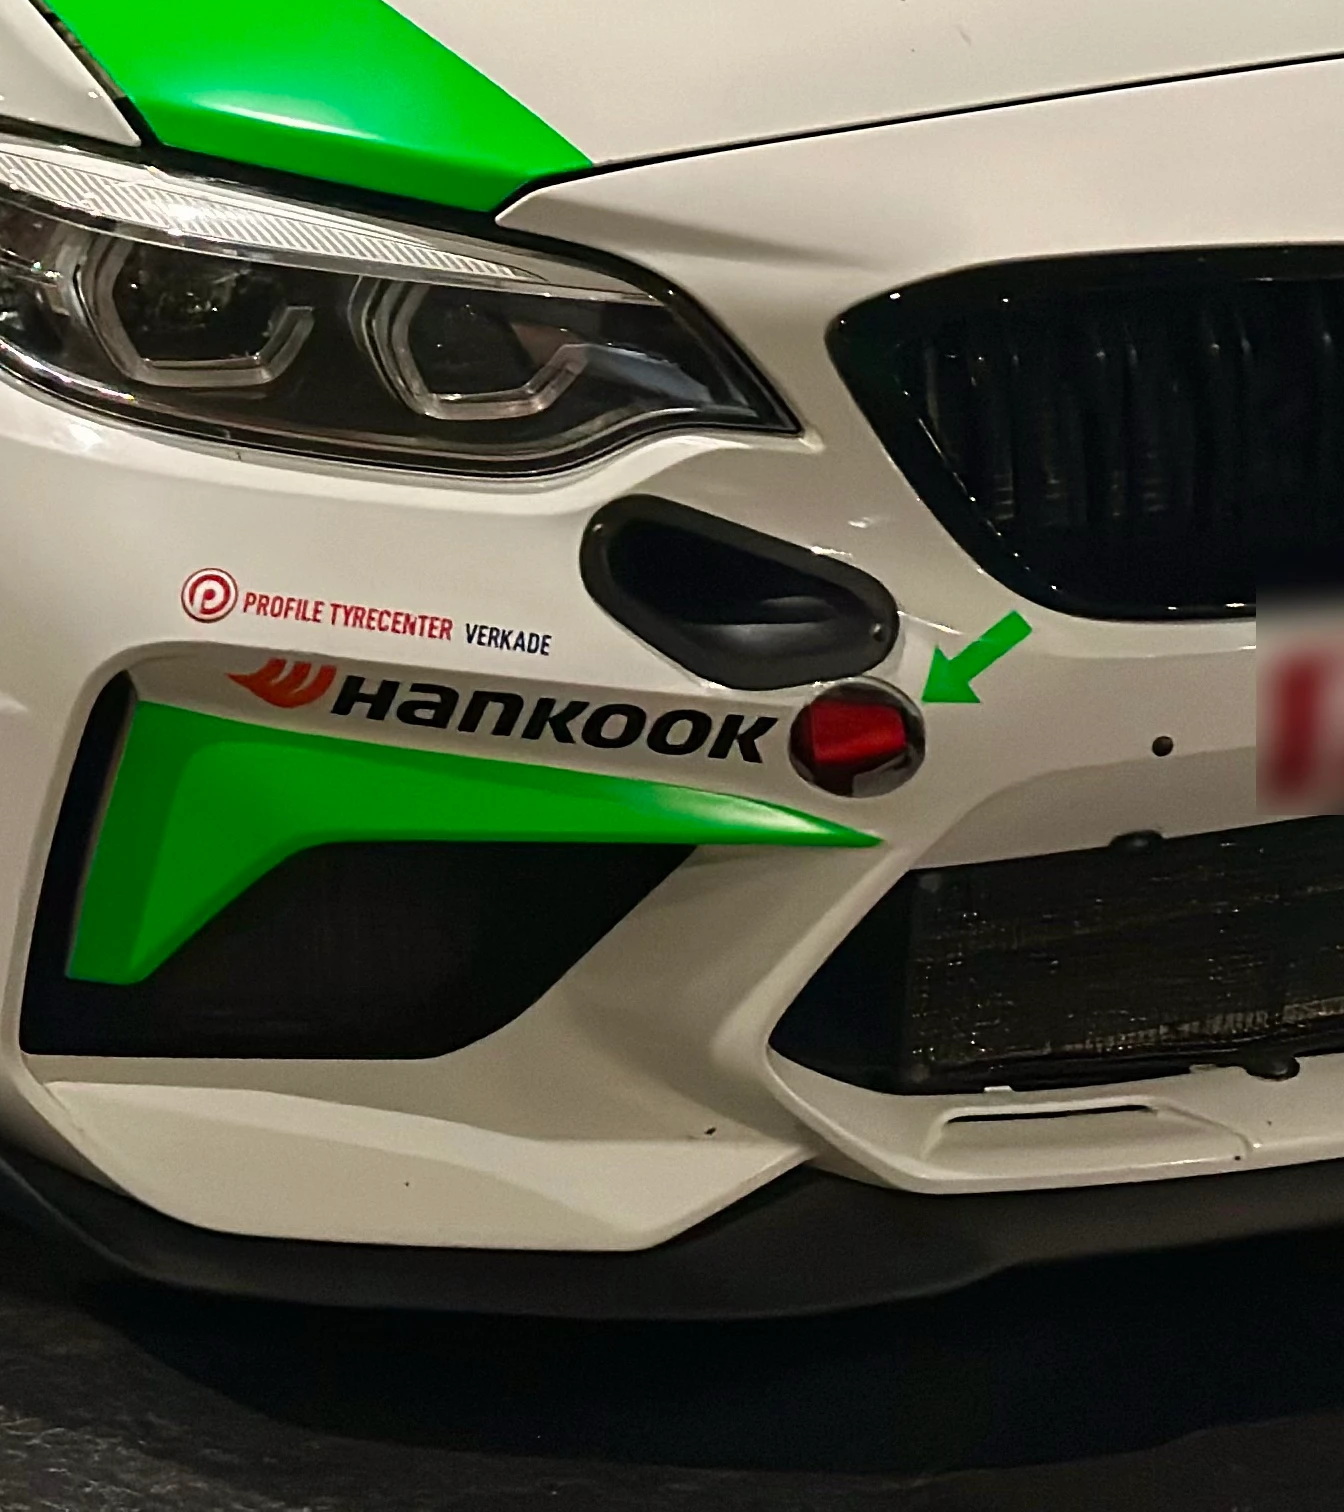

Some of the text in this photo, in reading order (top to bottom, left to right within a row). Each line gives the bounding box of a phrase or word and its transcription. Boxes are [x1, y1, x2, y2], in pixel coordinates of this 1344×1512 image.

[242, 591, 325, 624] PROFILE
[329, 602, 453, 641] TYRECENTER
[464, 622, 553, 657] VERKADE
